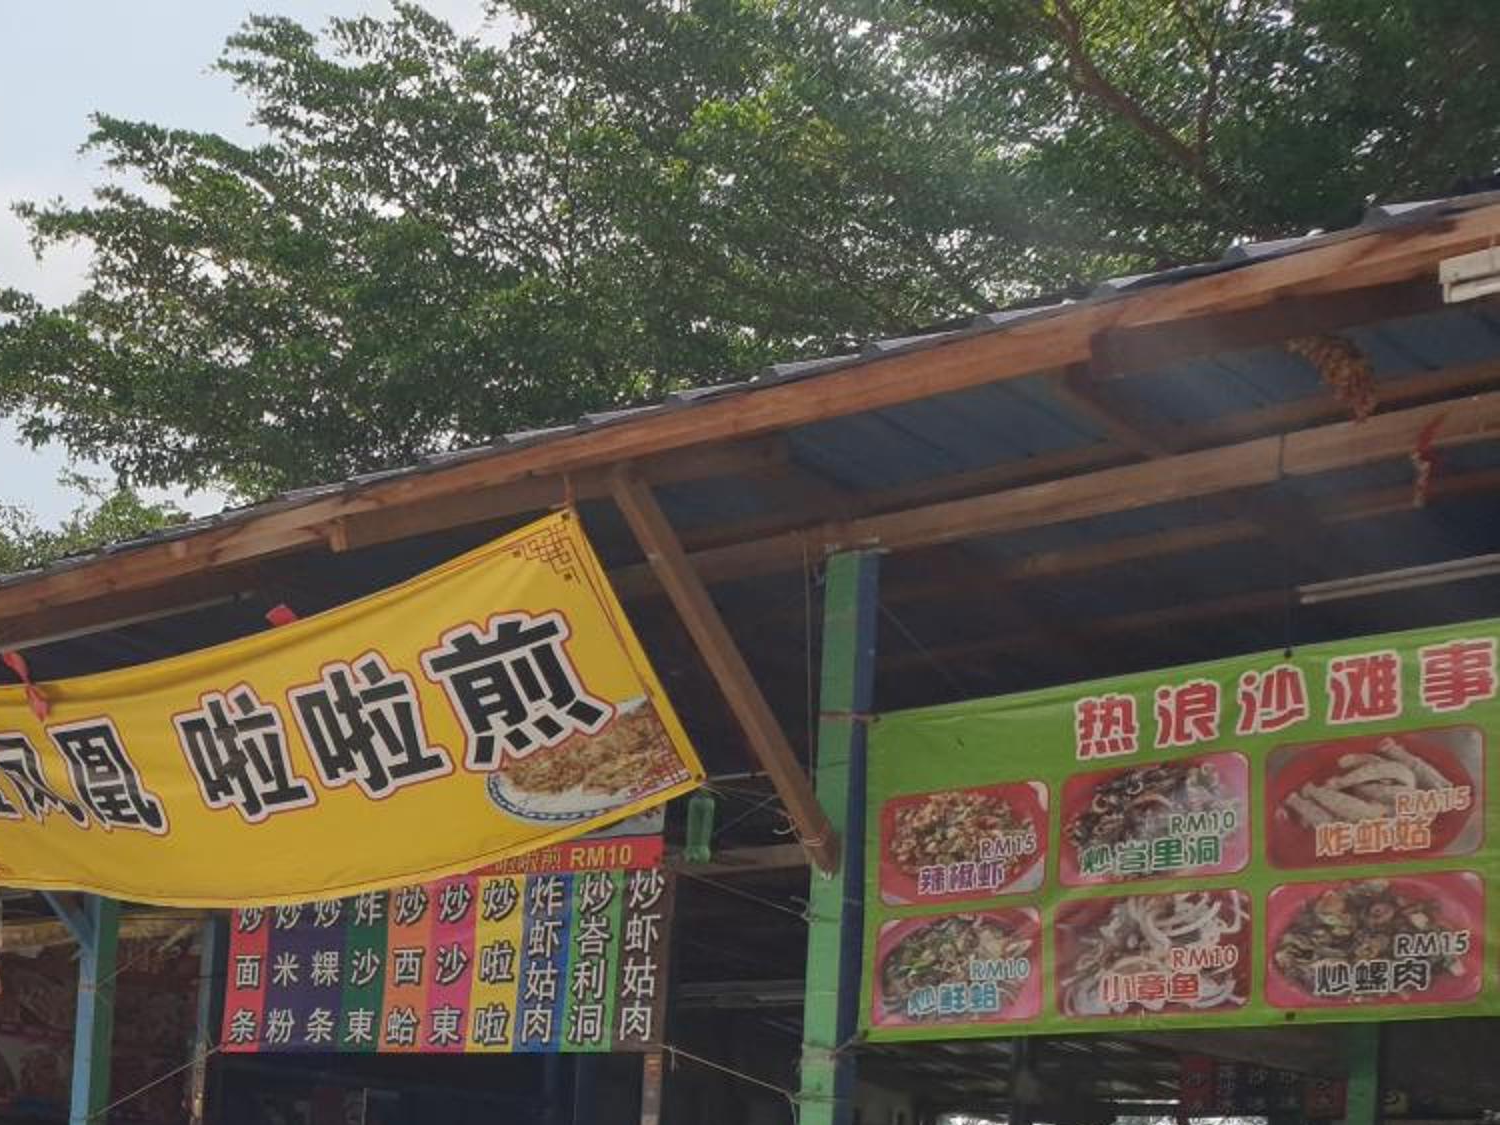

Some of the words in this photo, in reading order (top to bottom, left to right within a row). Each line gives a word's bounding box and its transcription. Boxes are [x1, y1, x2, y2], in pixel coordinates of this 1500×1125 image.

[173, 609, 615, 824] 啦啦煎
[1076, 638, 1497, 760] 热浪沙滩事
[1396, 786, 1471, 816] RM15
[1170, 810, 1237, 835] RM10
[570, 844, 632, 868] RM10
[980, 833, 1037, 860] RM15
[521, 875, 565, 1043] 炸虾姑肉
[619, 867, 665, 1041] 炒虾姑肉
[1171, 943, 1239, 969] RM10
[1396, 930, 1469, 956] RM15
[229, 905, 263, 1044] 炒面条
[265, 902, 301, 1044] 炒米粉
[387, 886, 427, 1044] 炒西蛤
[473, 880, 518, 1044] 炒啦啦
[969, 958, 1029, 980] RM10
[1315, 959, 1430, 995] 炒螺肉
[1101, 972, 1201, 1003] 小章鱼
